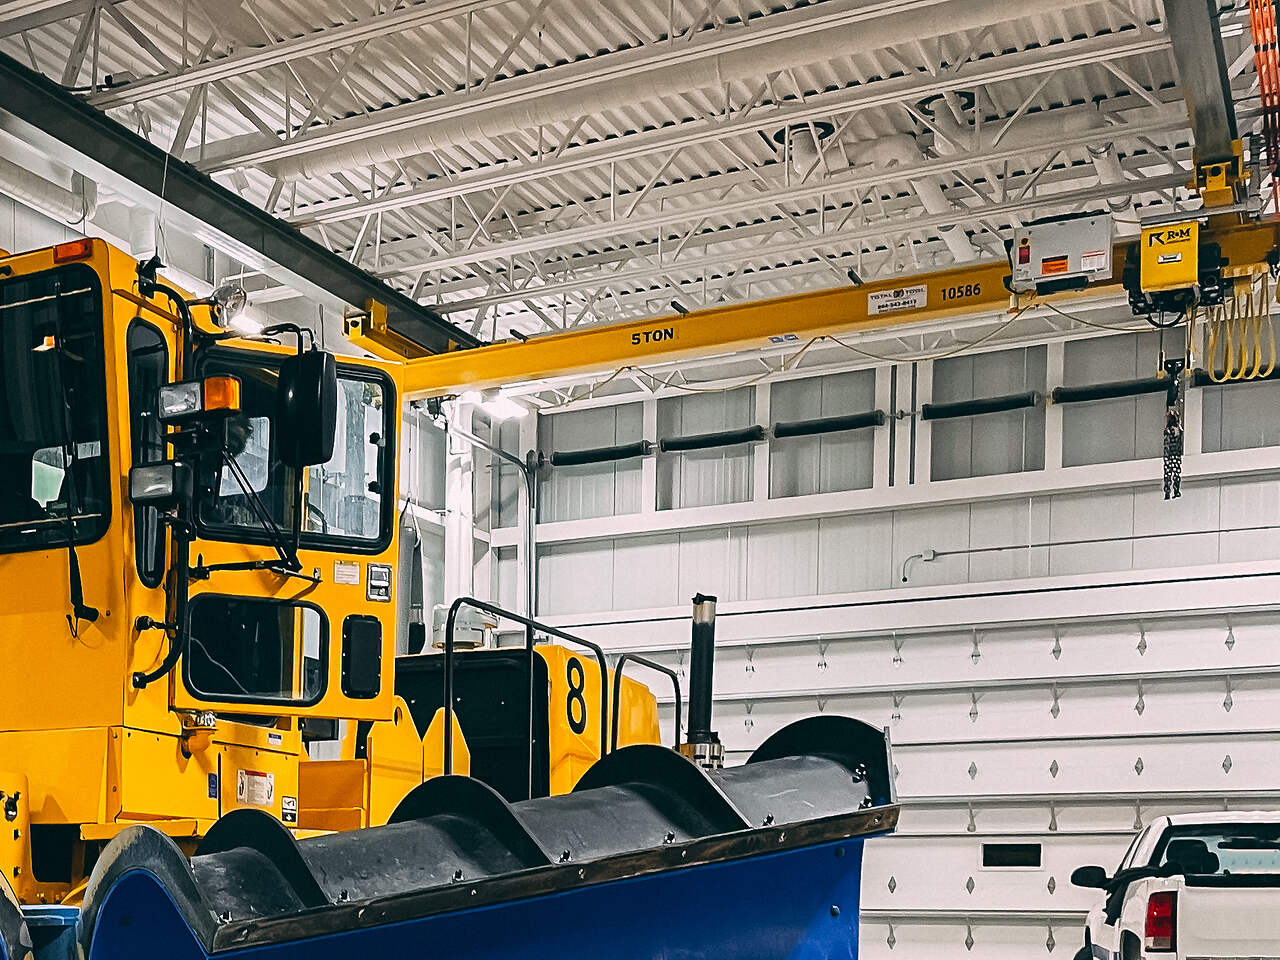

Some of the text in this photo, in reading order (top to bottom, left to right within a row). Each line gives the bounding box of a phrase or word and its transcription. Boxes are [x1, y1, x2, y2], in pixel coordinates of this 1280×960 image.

[941, 283, 981, 301] 10586
[631, 327, 674, 345] 5 TON
[566, 656, 587, 735] 8
